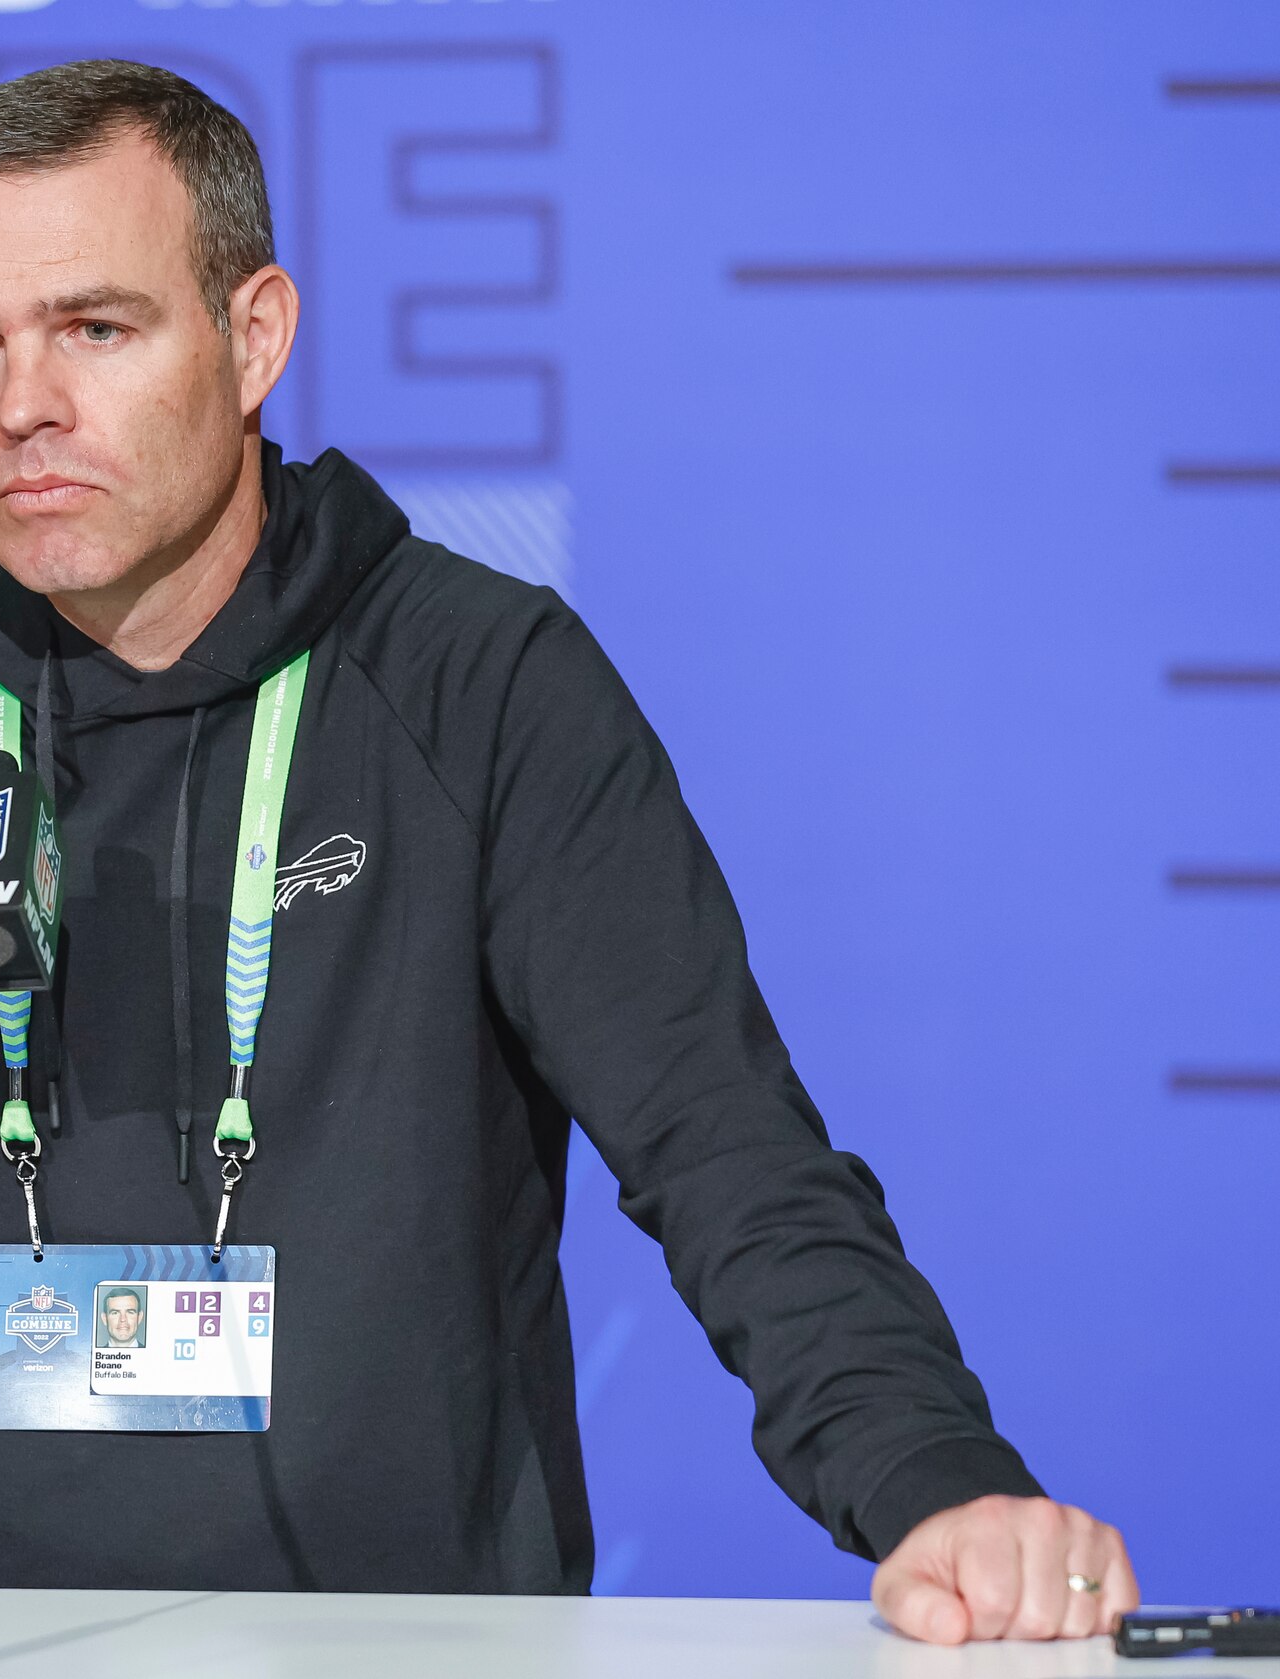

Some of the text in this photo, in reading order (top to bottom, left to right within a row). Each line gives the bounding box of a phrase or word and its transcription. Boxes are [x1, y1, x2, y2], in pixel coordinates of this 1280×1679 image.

[267, 708, 282, 754] SCOUTING
[263, 756, 273, 780] 2022
[36, 850, 55, 911] NFL
[24, 889, 54, 975] NFLN
[35, 1297, 50, 1308] NFL
[182, 1295, 266, 1311] 1 2 4
[12, 1320, 72, 1330] COMBINE
[203, 1318, 265, 1335] 6 9
[95, 1351, 131, 1360] Brandon
[175, 1342, 195, 1358] 10
[23, 1364, 54, 1372] verizon
[95, 1361, 122, 1369] Beane
